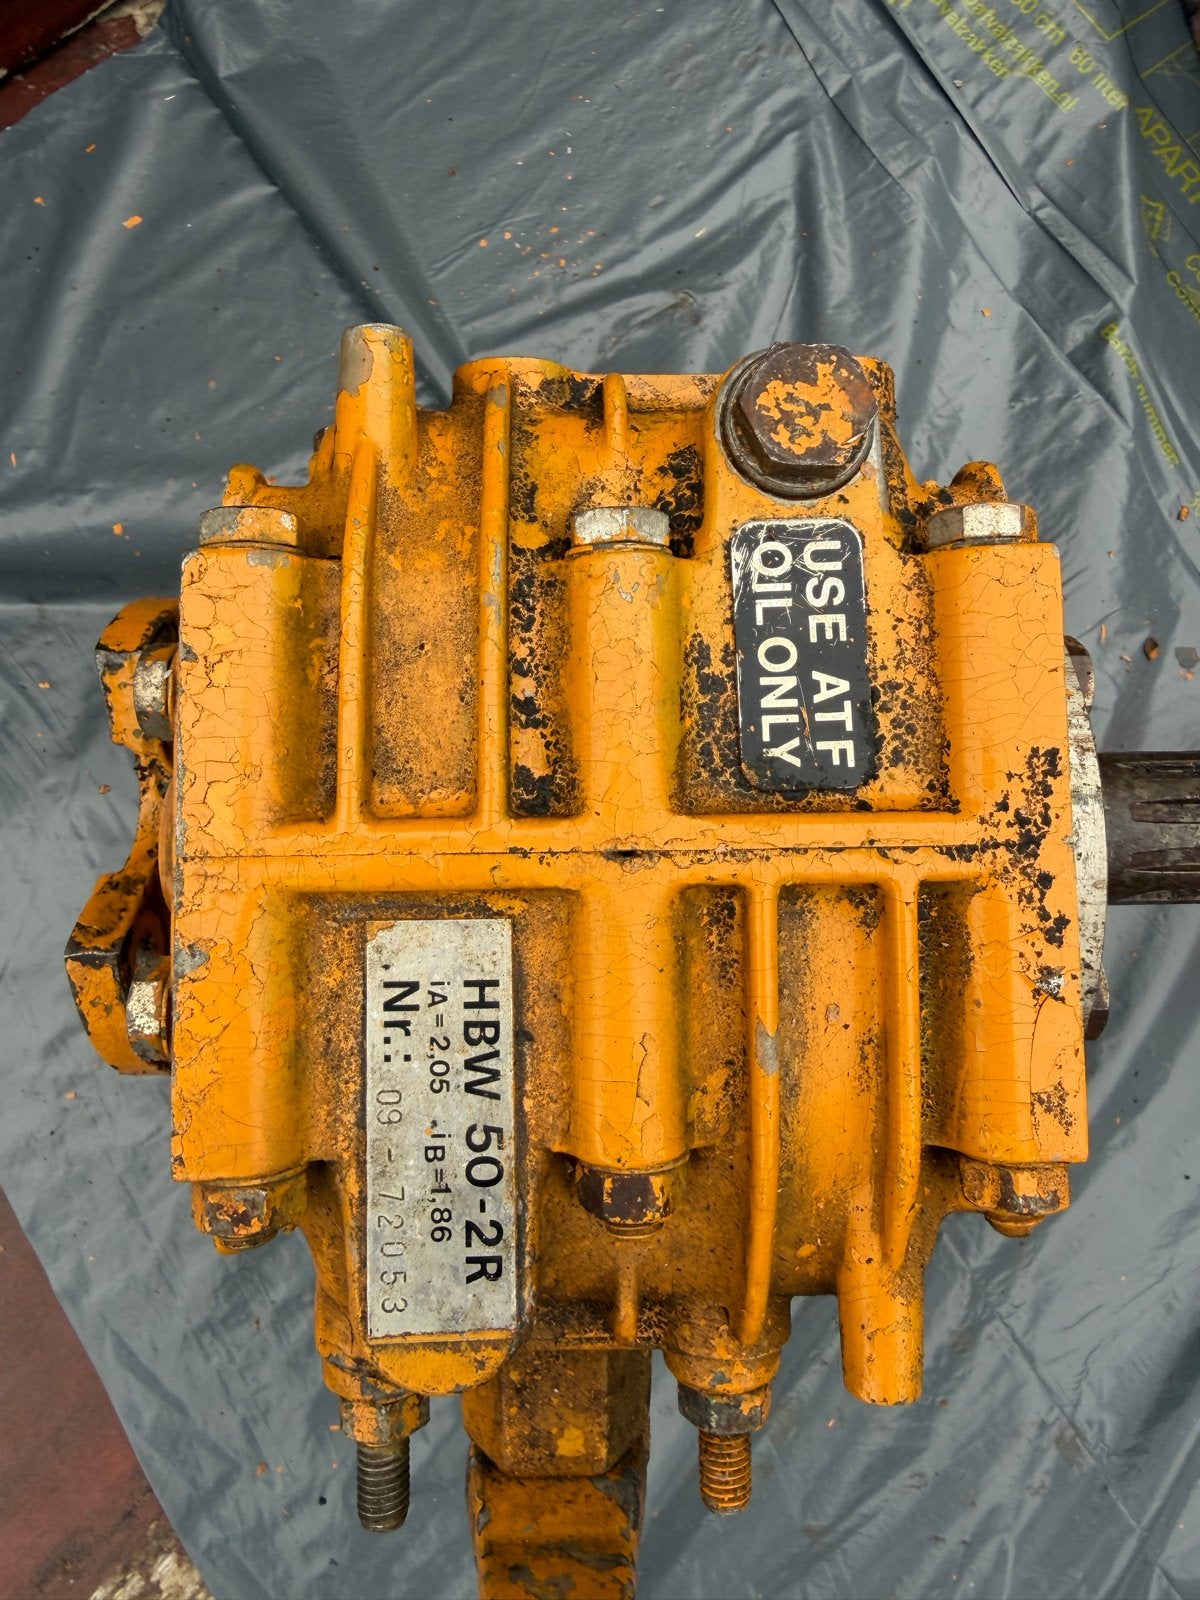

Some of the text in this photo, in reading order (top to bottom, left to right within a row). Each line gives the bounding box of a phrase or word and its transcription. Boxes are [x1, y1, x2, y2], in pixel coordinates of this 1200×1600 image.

[1091, 71, 1129, 111] liter
[752, 541, 802, 768] OIL ONLY
[803, 540, 856, 768] USE ATF
[382, 980, 421, 1064] Nr.:
[462, 979, 502, 1101] HBW
[377, 1185, 408, 1315] 72053
